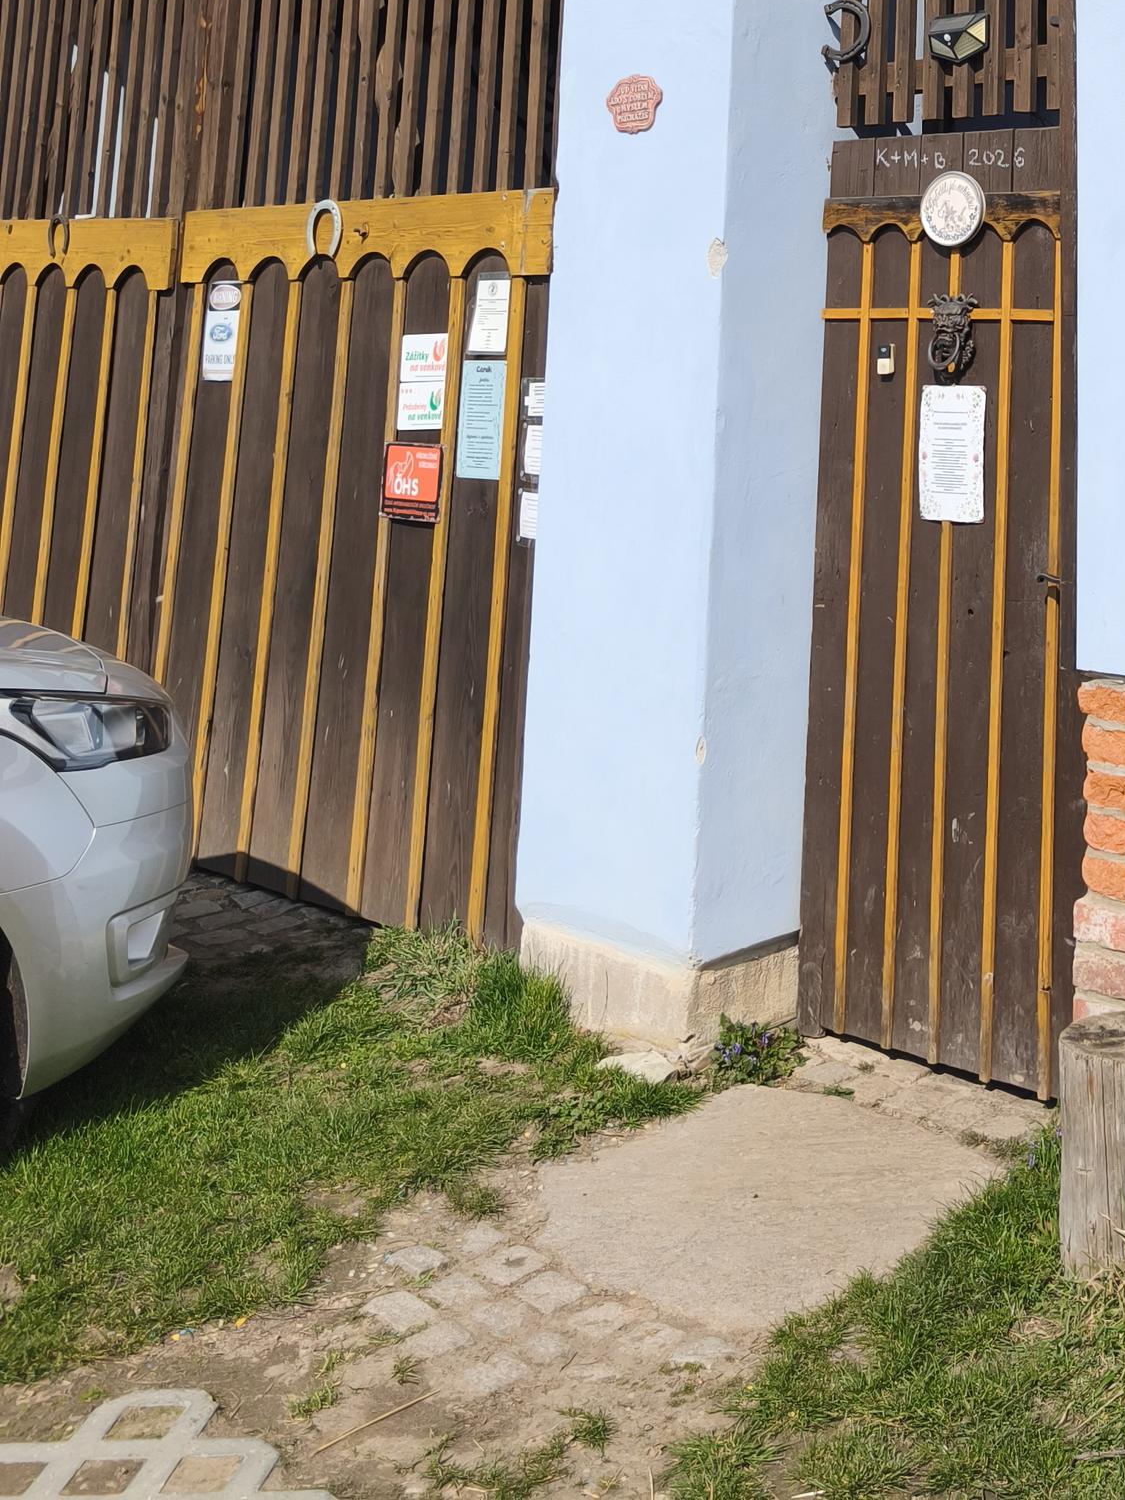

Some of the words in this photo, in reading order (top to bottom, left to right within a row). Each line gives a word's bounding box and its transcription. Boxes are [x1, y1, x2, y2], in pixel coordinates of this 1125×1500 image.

[968, 147, 1025, 168] 2026
[405, 351, 429, 363] Zážitky
[407, 413, 416, 421] na
